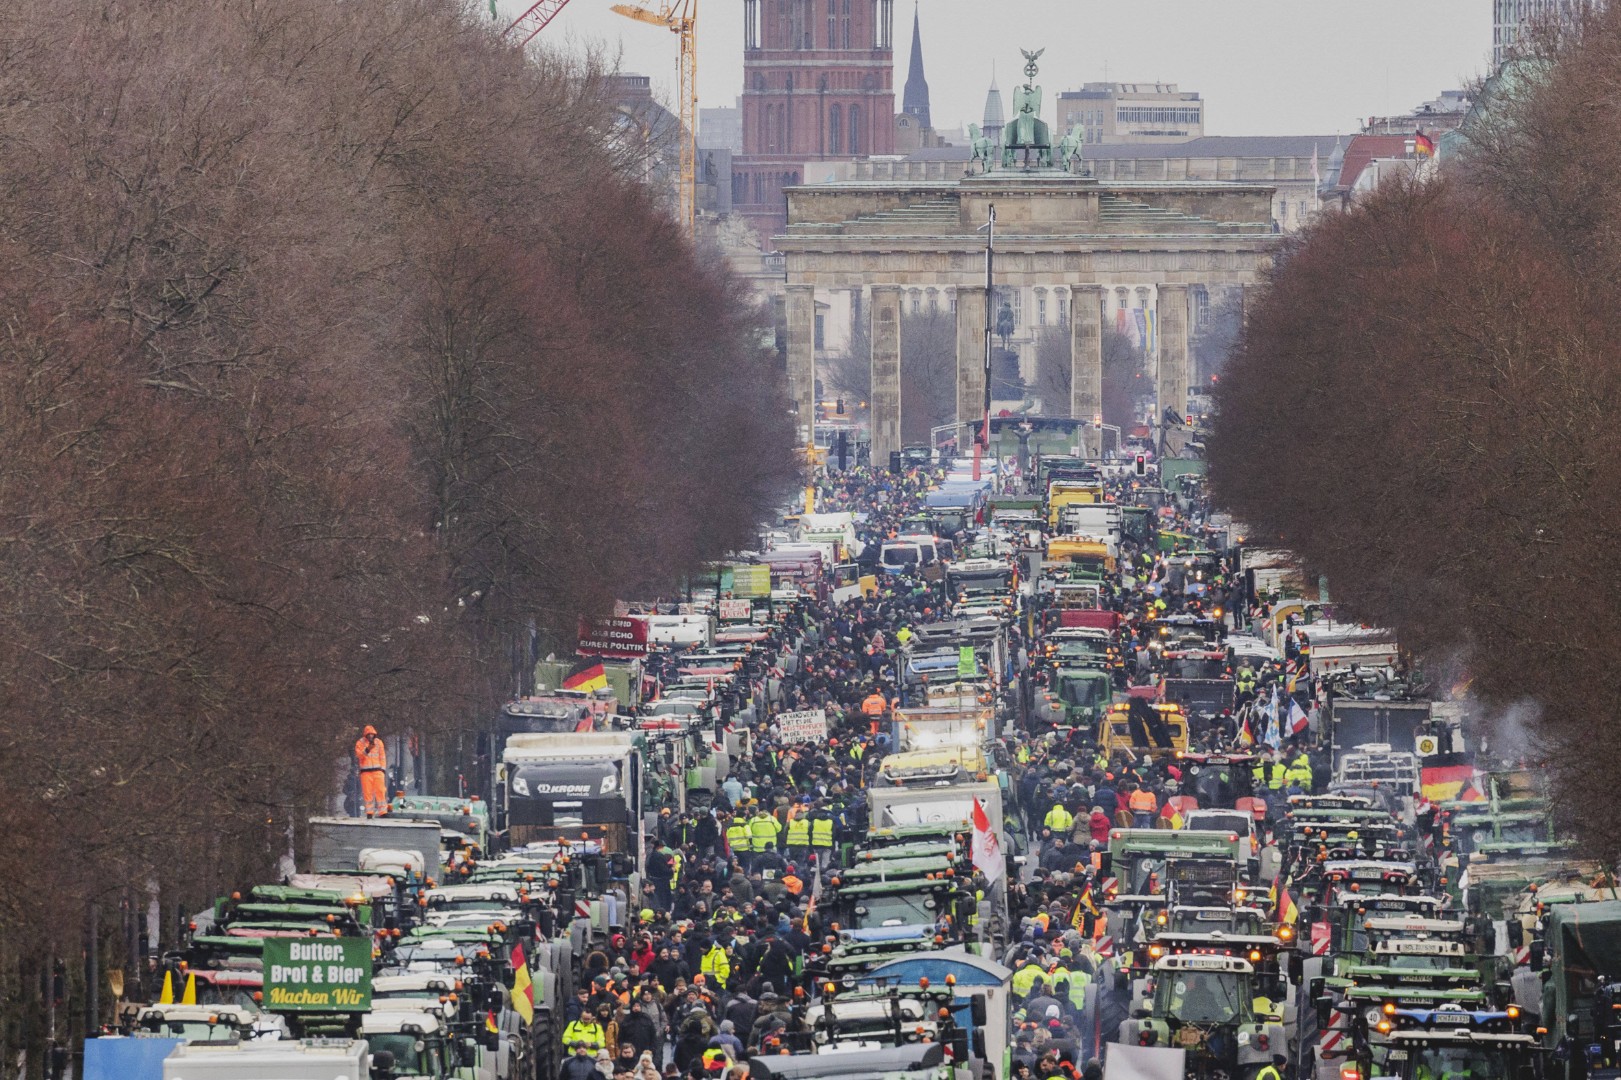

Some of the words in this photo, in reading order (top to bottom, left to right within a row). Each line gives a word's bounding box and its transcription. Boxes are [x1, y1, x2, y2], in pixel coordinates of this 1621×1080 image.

[610, 631, 634, 639] ECHO
[580, 640, 608, 648] EURER
[610, 642, 644, 651] POLITIK
[789, 711, 819, 719] HANDWERK
[551, 785, 591, 793] KRONE
[290, 942, 345, 962] Butter,
[271, 964, 308, 984] Brot
[311, 965, 324, 984] &
[327, 965, 364, 984] Bier
[270, 987, 329, 1004] Machen
[331, 988, 365, 1005] Wir
[1369, 1013, 1378, 1022] 40
